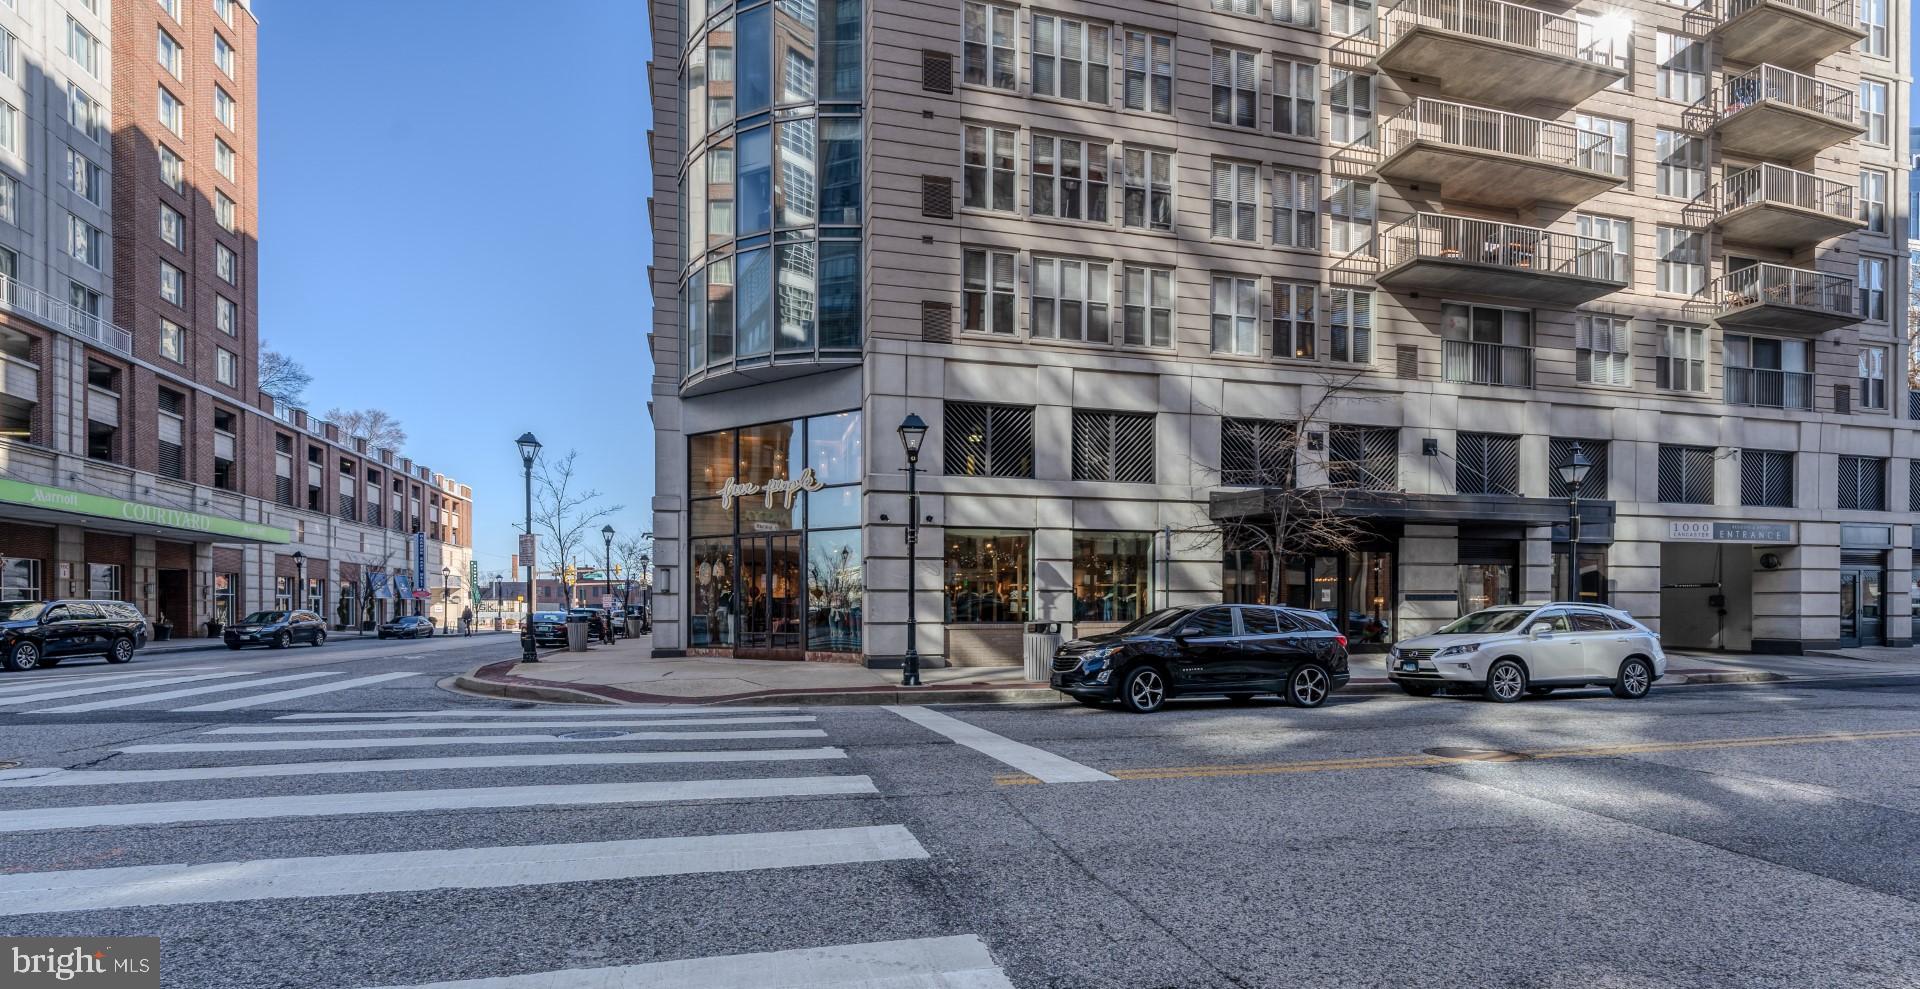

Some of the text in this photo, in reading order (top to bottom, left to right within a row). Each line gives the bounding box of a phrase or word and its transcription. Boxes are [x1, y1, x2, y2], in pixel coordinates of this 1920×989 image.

[31, 488, 78, 506] Marriott
[716, 468, 824, 510] free people
[122, 502, 211, 530] COURTYARD
[1673, 523, 1710, 533] 1000
[1719, 530, 1782, 541] ENTRANCE
